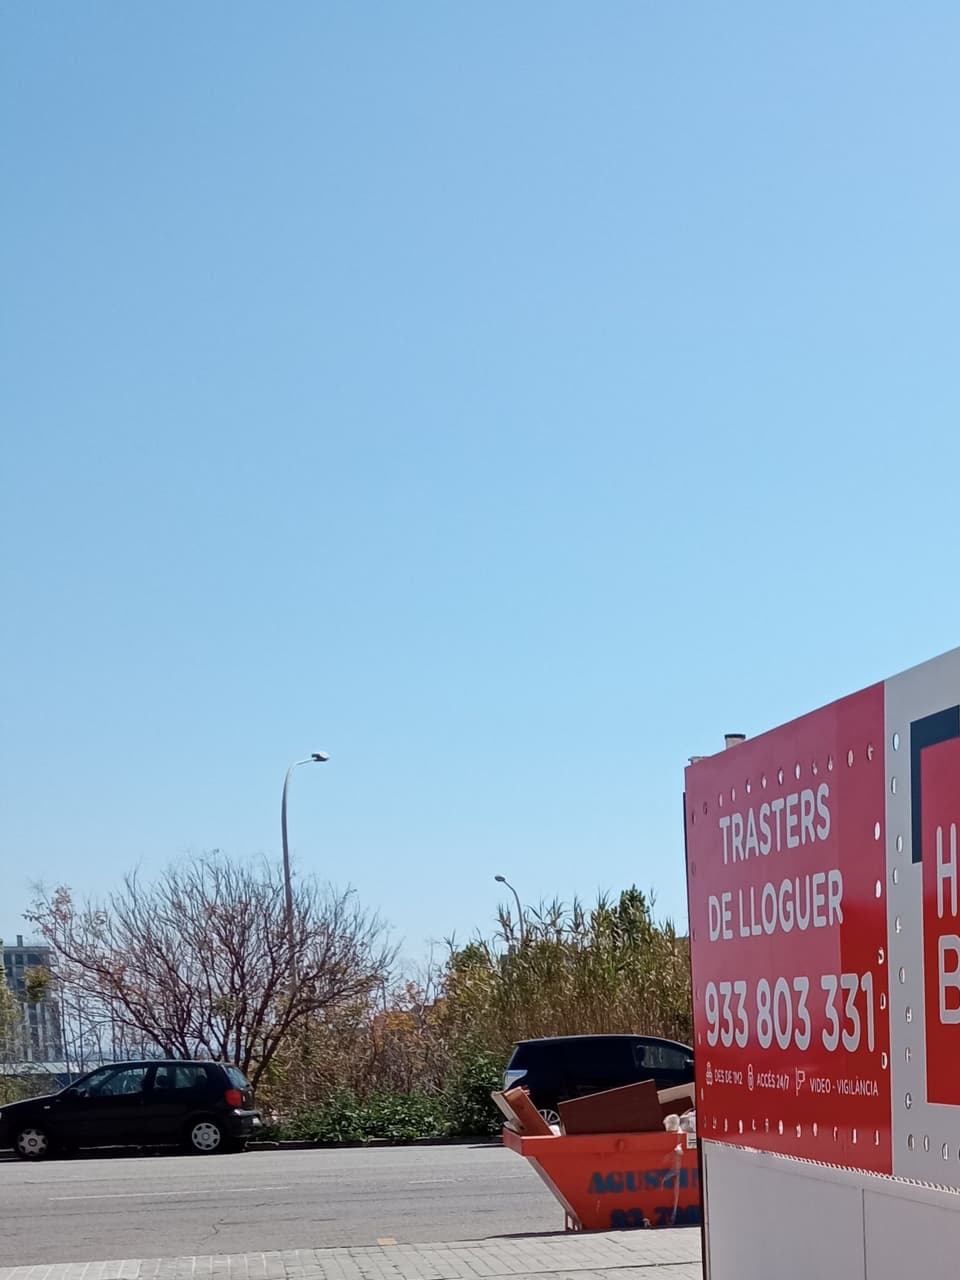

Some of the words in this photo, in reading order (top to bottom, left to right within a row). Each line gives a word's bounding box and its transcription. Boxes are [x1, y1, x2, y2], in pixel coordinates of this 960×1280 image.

[719, 783, 831, 865] TRASTERS
[708, 892, 734, 942] DE
[739, 869, 844, 938] LLOGUER
[704, 980, 748, 1048] 933
[757, 976, 811, 1051] 803
[821, 972, 876, 1053] 331
[809, 1078, 831, 1094] VIDEO
[588, 1168, 699, 1195] AGUSTI
